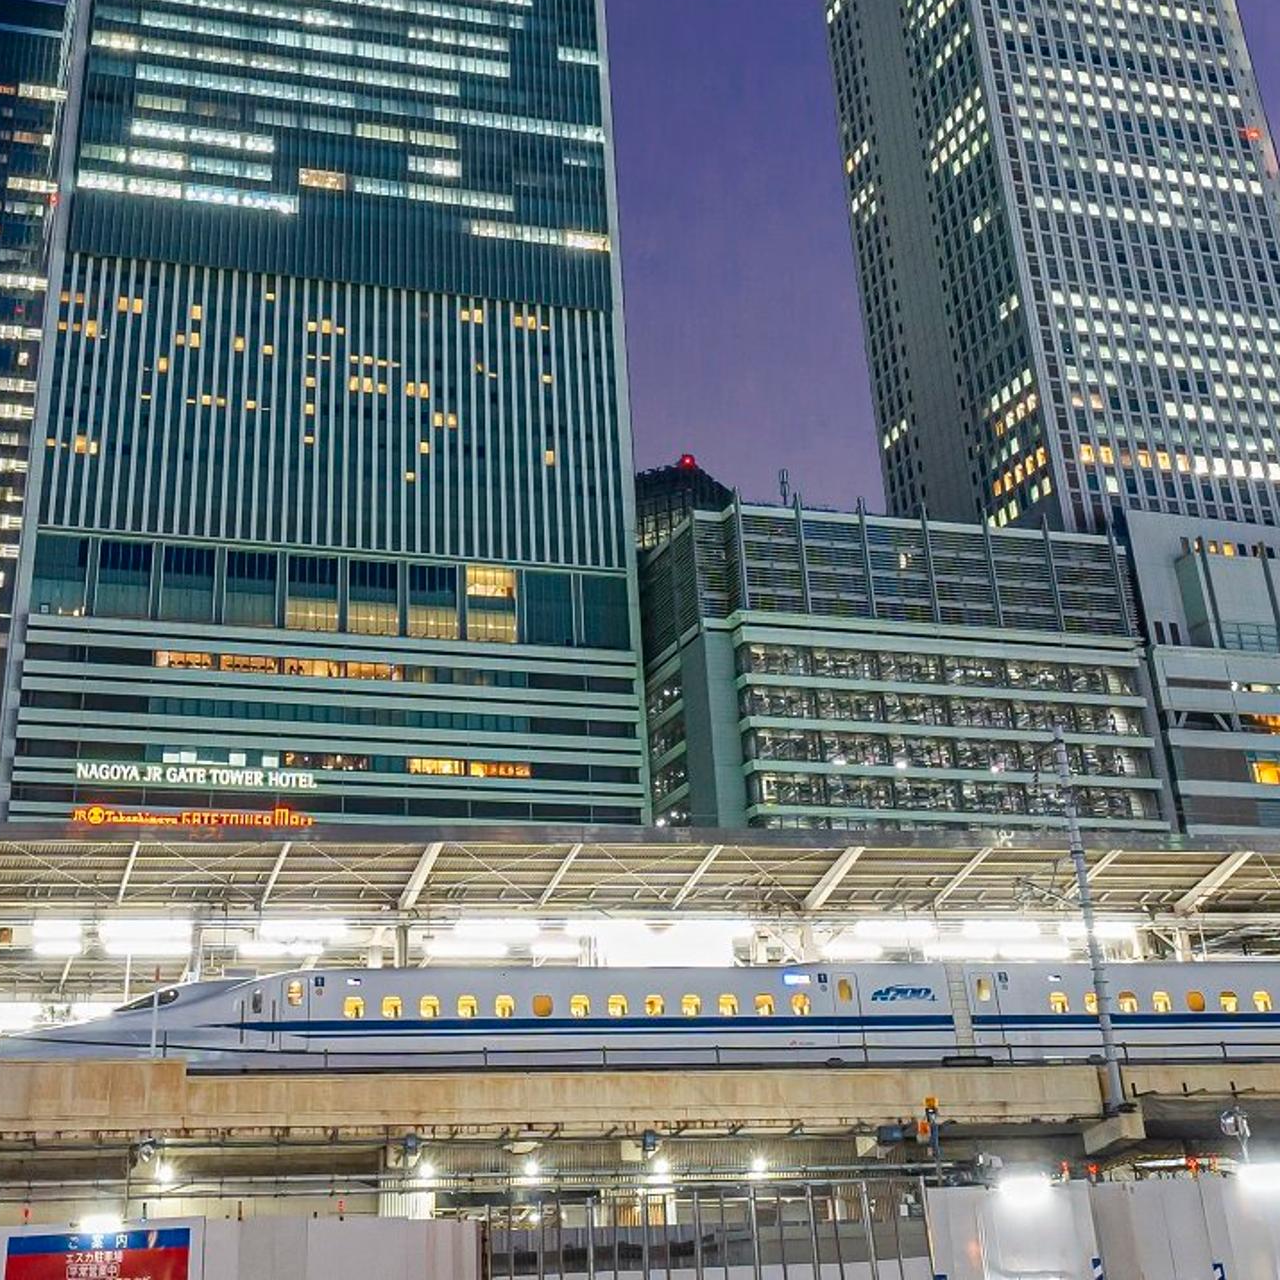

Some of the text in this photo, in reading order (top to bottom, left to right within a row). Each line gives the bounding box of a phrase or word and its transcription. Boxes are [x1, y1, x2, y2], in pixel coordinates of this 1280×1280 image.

[77, 762, 318, 788] NAGOYA JR GATE TOWER HOTEL
[73, 810, 87, 821] JR
[68, 1234, 128, 1249] ご案内
